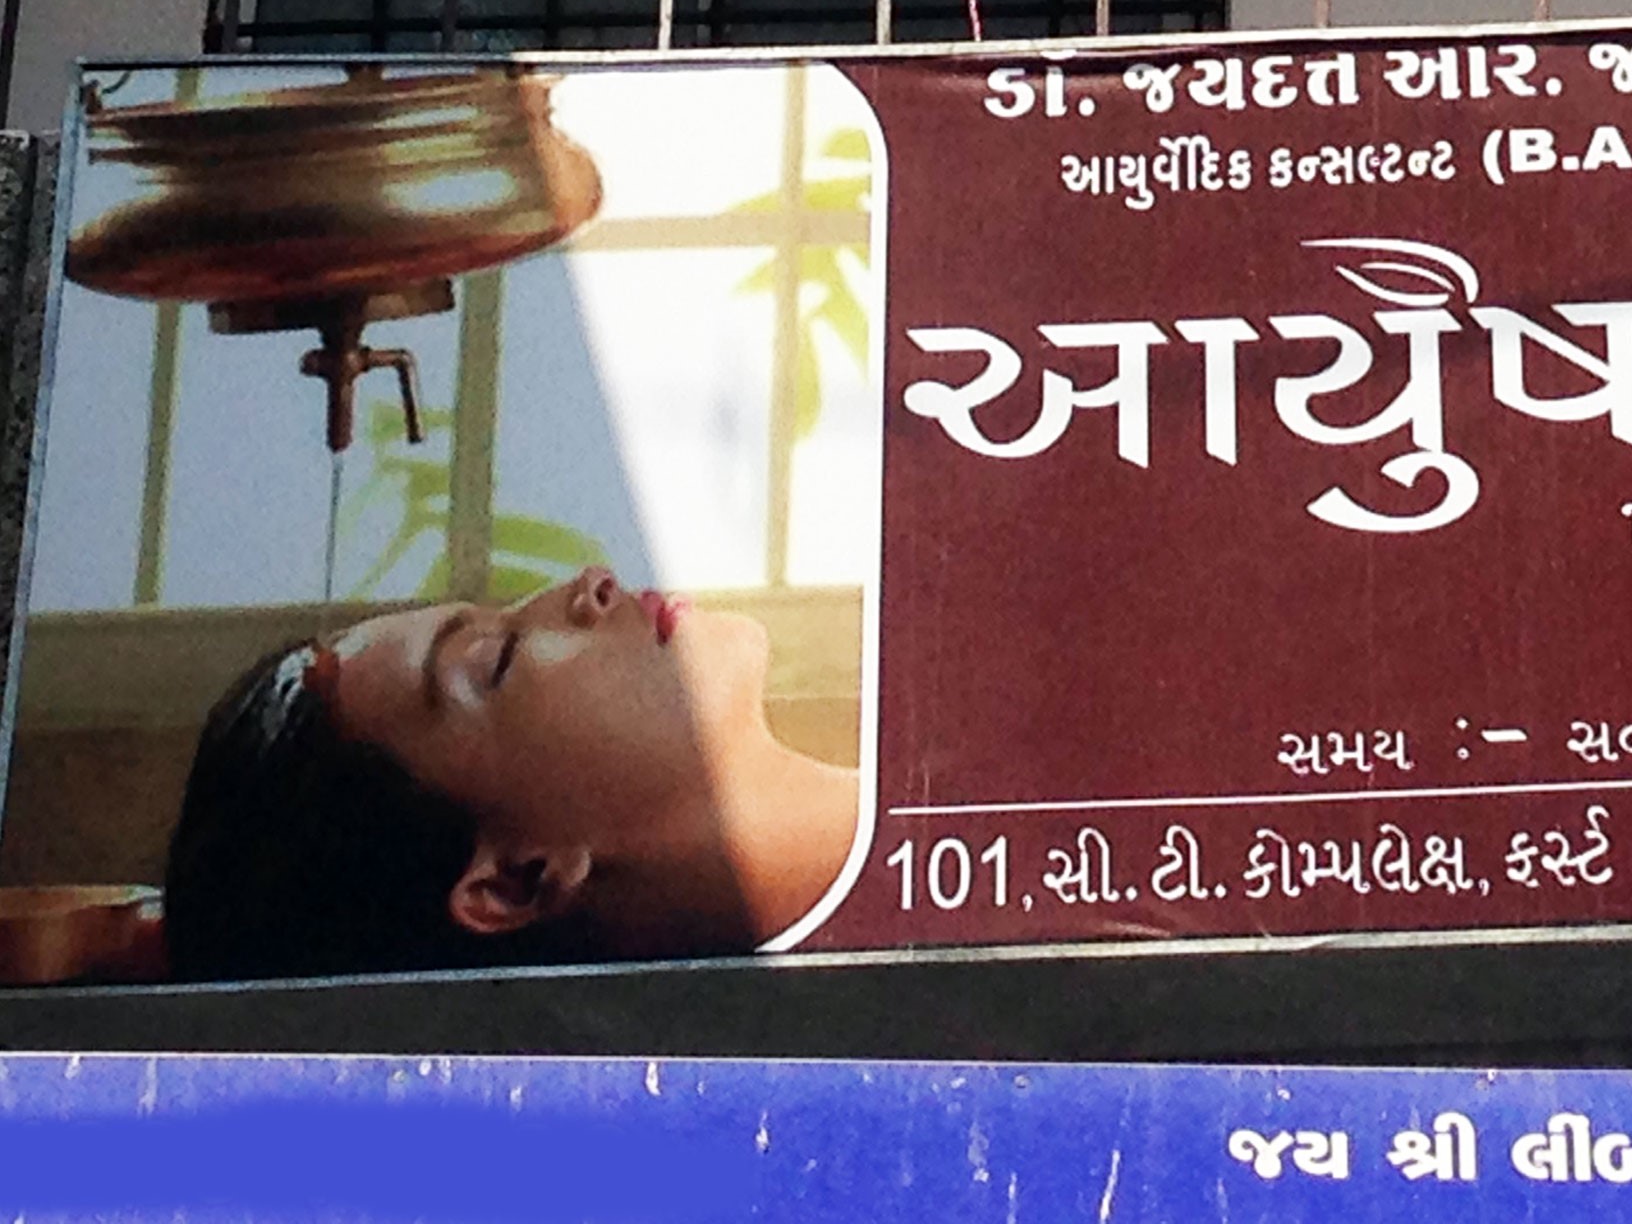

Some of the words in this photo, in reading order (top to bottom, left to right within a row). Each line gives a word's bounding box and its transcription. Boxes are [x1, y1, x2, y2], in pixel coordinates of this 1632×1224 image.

[1118, 48, 1361, 114] જયદત્ત
[1382, 43, 1564, 101] આર.
[1275, 728, 1415, 775] સમય
[1226, 1128, 1350, 1181] જય
[1385, 1111, 1478, 1182] શ્રી
